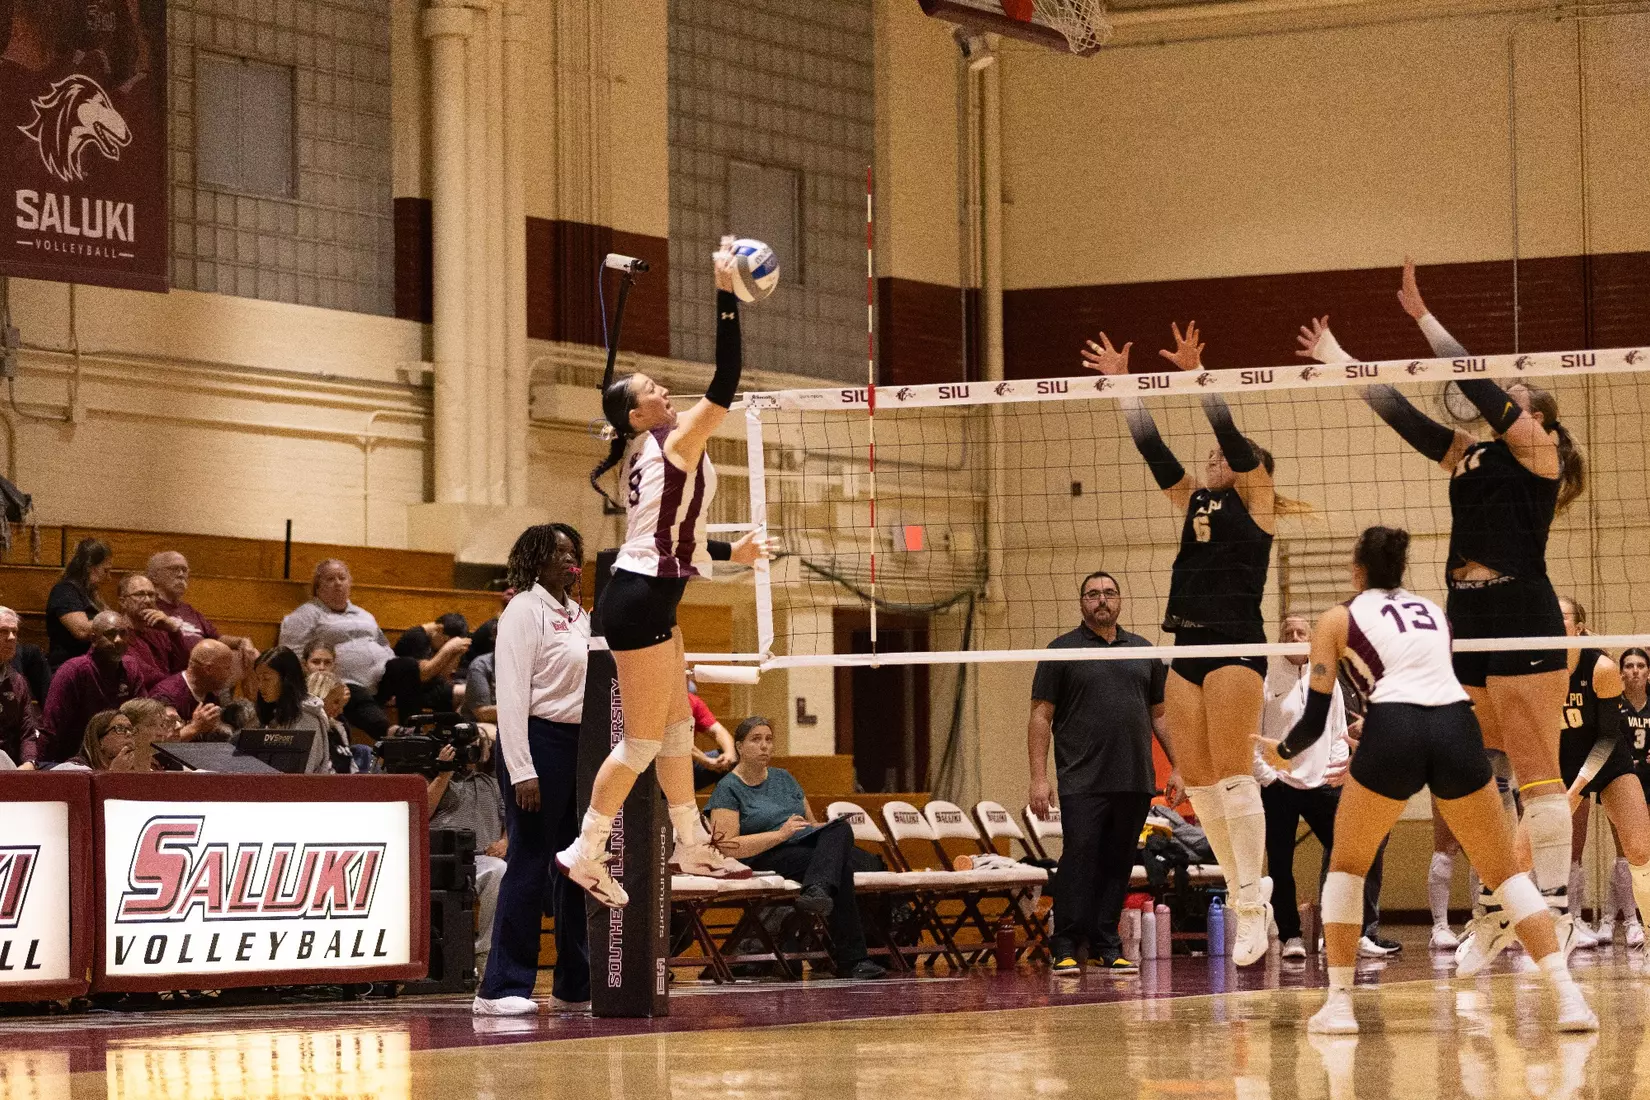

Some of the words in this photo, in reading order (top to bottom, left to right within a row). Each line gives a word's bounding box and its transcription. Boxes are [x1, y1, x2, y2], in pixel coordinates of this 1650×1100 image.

[16, 189, 134, 242] SALUKI
[36, 239, 117, 258] VOLLEYBALL
[938, 385, 969, 399] SIU
[1037, 380, 1068, 394] SIU
[1138, 375, 1170, 389] SIU
[1240, 370, 1273, 384] SIU
[1345, 364, 1378, 378] SIU
[1452, 358, 1486, 373] SIU
[1561, 353, 1595, 368] SIU
[629, 468, 642, 507] 8
[1193, 515, 1211, 542] 6
[1380, 602, 1438, 633] 13
[1628, 716, 1650, 728] VALP
[1634, 729, 1646, 750] 3
[115, 815, 387, 924] SALUKI
[115, 928, 388, 965] VOLLEYBALL
[608, 905, 623, 987] SOUTHE
